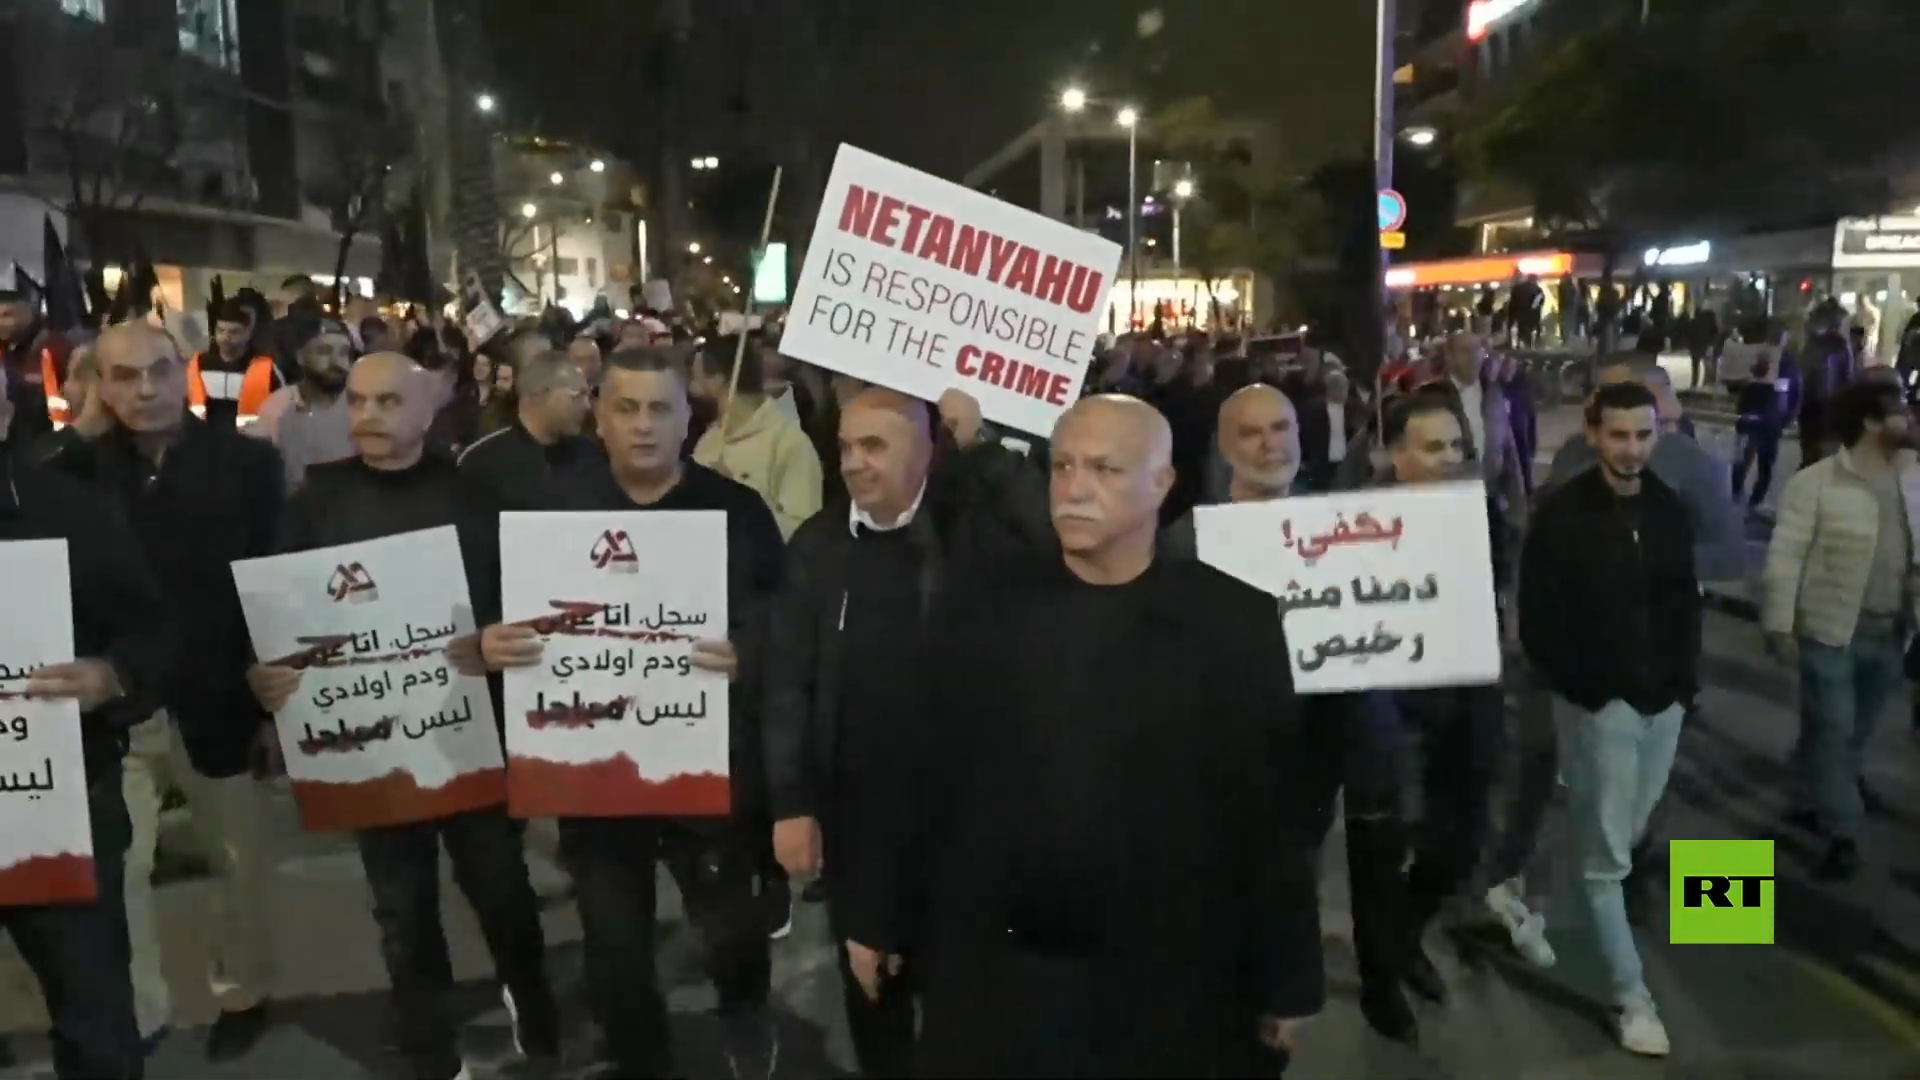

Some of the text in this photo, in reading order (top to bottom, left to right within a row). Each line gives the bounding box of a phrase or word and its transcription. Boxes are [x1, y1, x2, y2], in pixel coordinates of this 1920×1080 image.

[838, 184, 1103, 314] NETANYAHU
[823, 248, 1086, 365] IS RESPONSIBLE
[808, 294, 1072, 408] FOR THE CRIME
[1351, 573, 1439, 604] دمنا
[552, 648, 691, 684] ودم اولادي
[1297, 620, 1424, 672] رخيص
[312, 666, 449, 714] ودم اولادي
[636, 690, 707, 727] ليس
[402, 695, 472, 739] ليس
